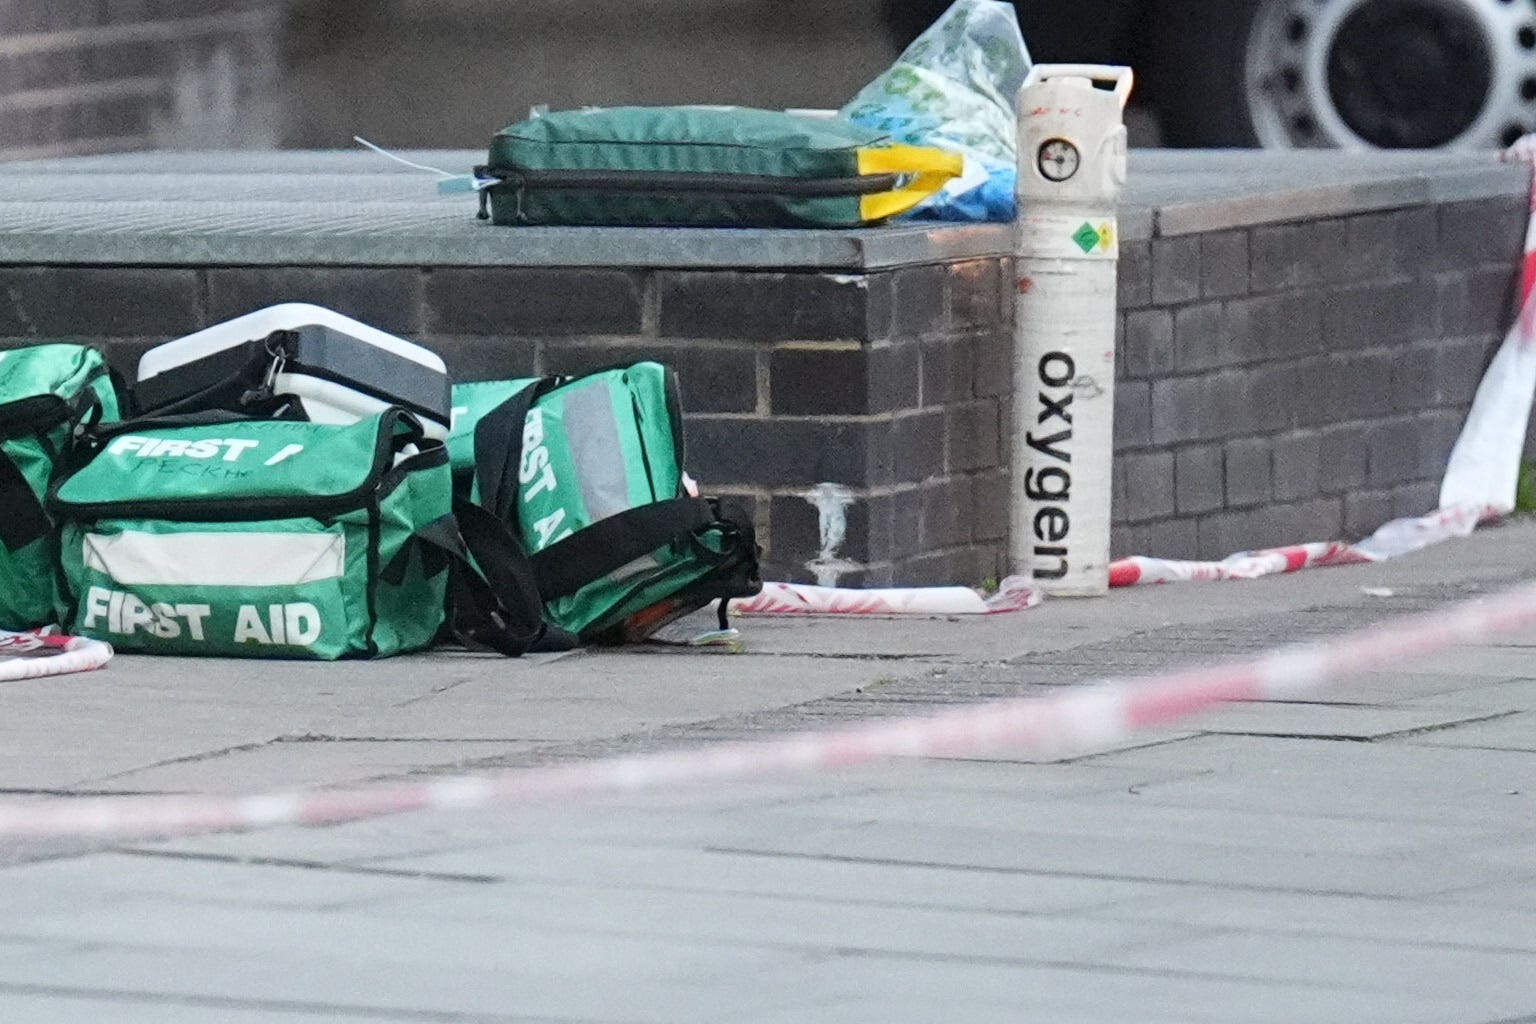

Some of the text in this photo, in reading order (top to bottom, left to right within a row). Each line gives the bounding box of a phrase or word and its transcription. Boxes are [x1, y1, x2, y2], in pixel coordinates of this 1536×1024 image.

[107, 435, 259, 462] FIRST
[1024, 351, 1076, 580] oxygen
[83, 585, 322, 646] FIRST AID
